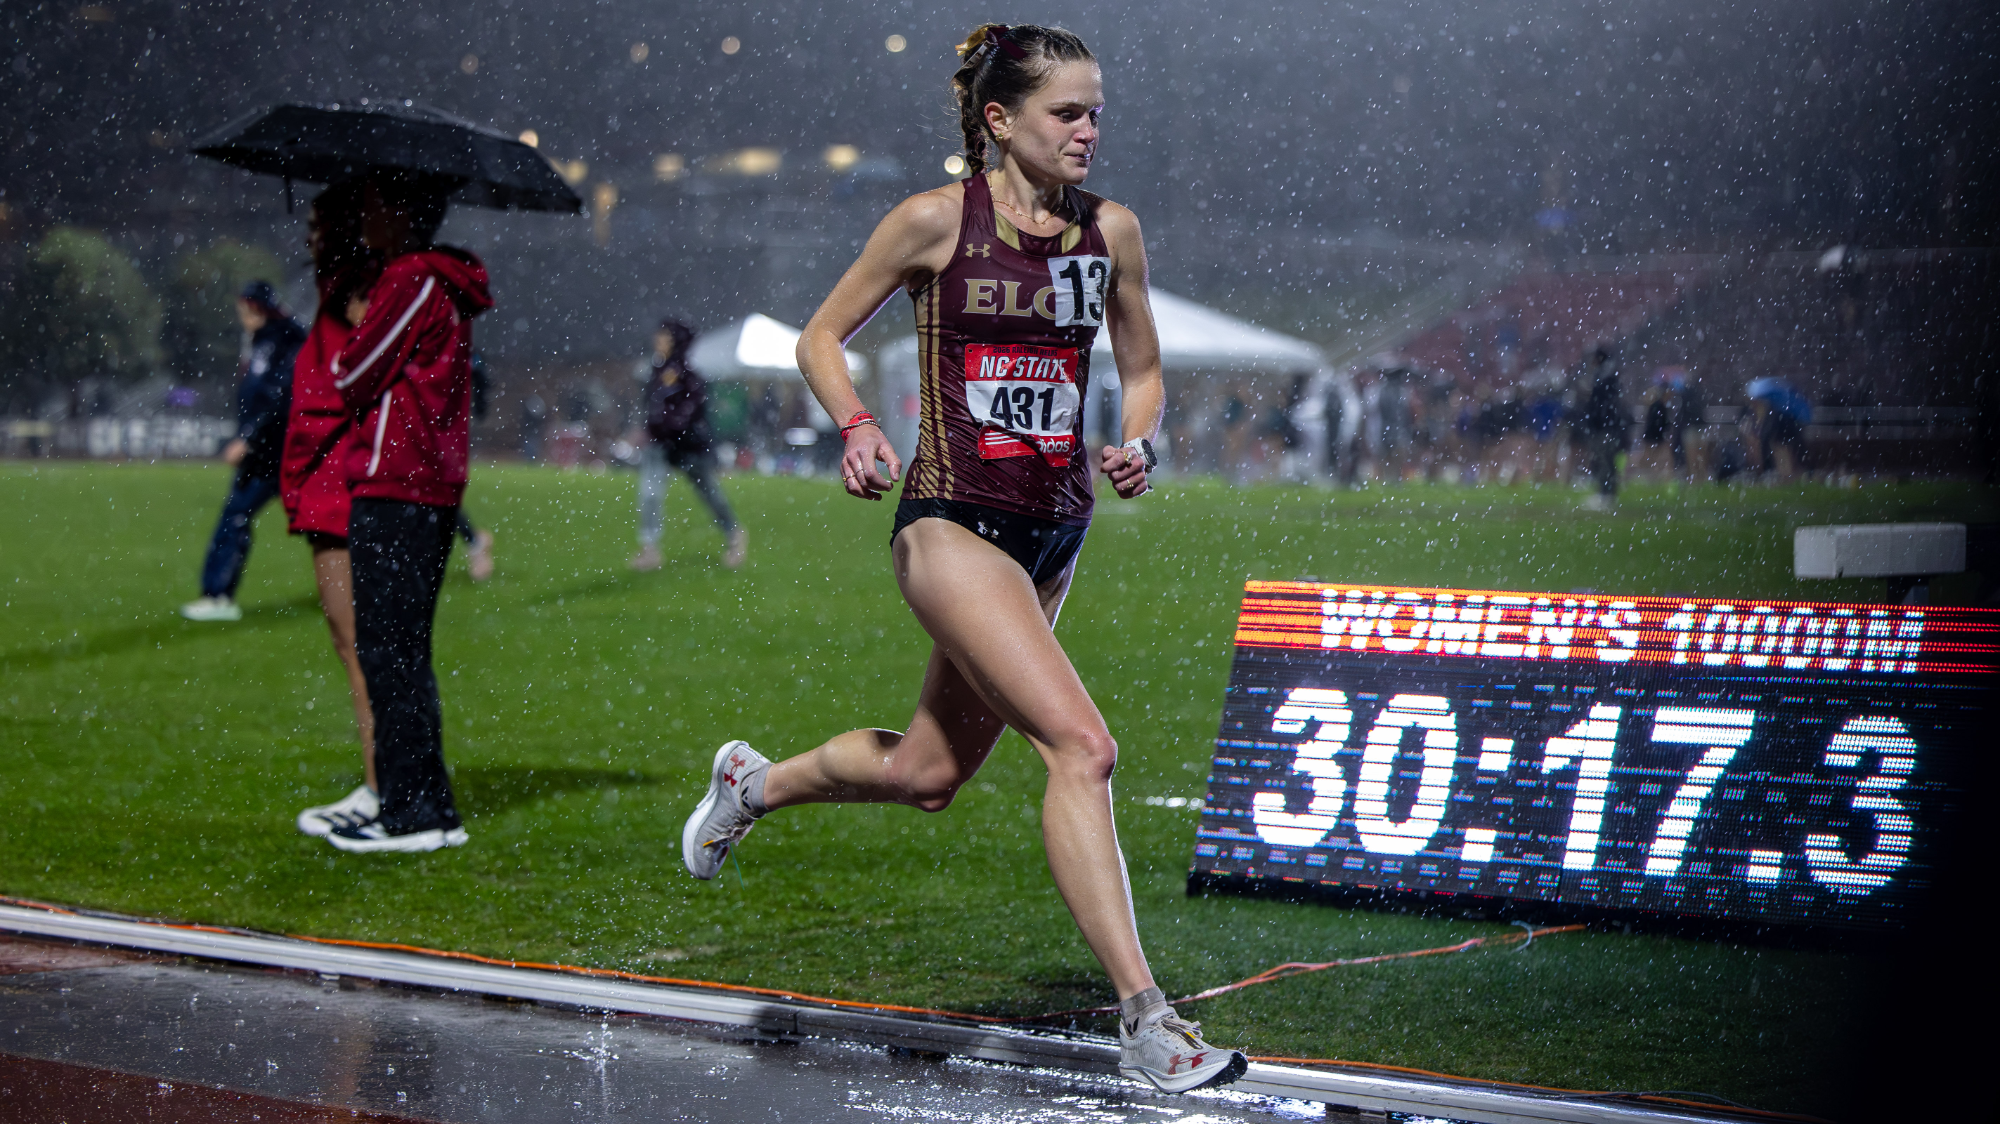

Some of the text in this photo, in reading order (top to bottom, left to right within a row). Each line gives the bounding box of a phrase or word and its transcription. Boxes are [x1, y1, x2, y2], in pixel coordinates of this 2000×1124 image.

[961, 278, 1056, 320] ELO
[1058, 260, 1107, 321] 13
[979, 355, 1069, 381] NC STATE
[989, 386, 1056, 431] 431
[1320, 588, 1925, 674] WOMEN'S 10000M
[1252, 687, 1918, 896] 30:17.3
